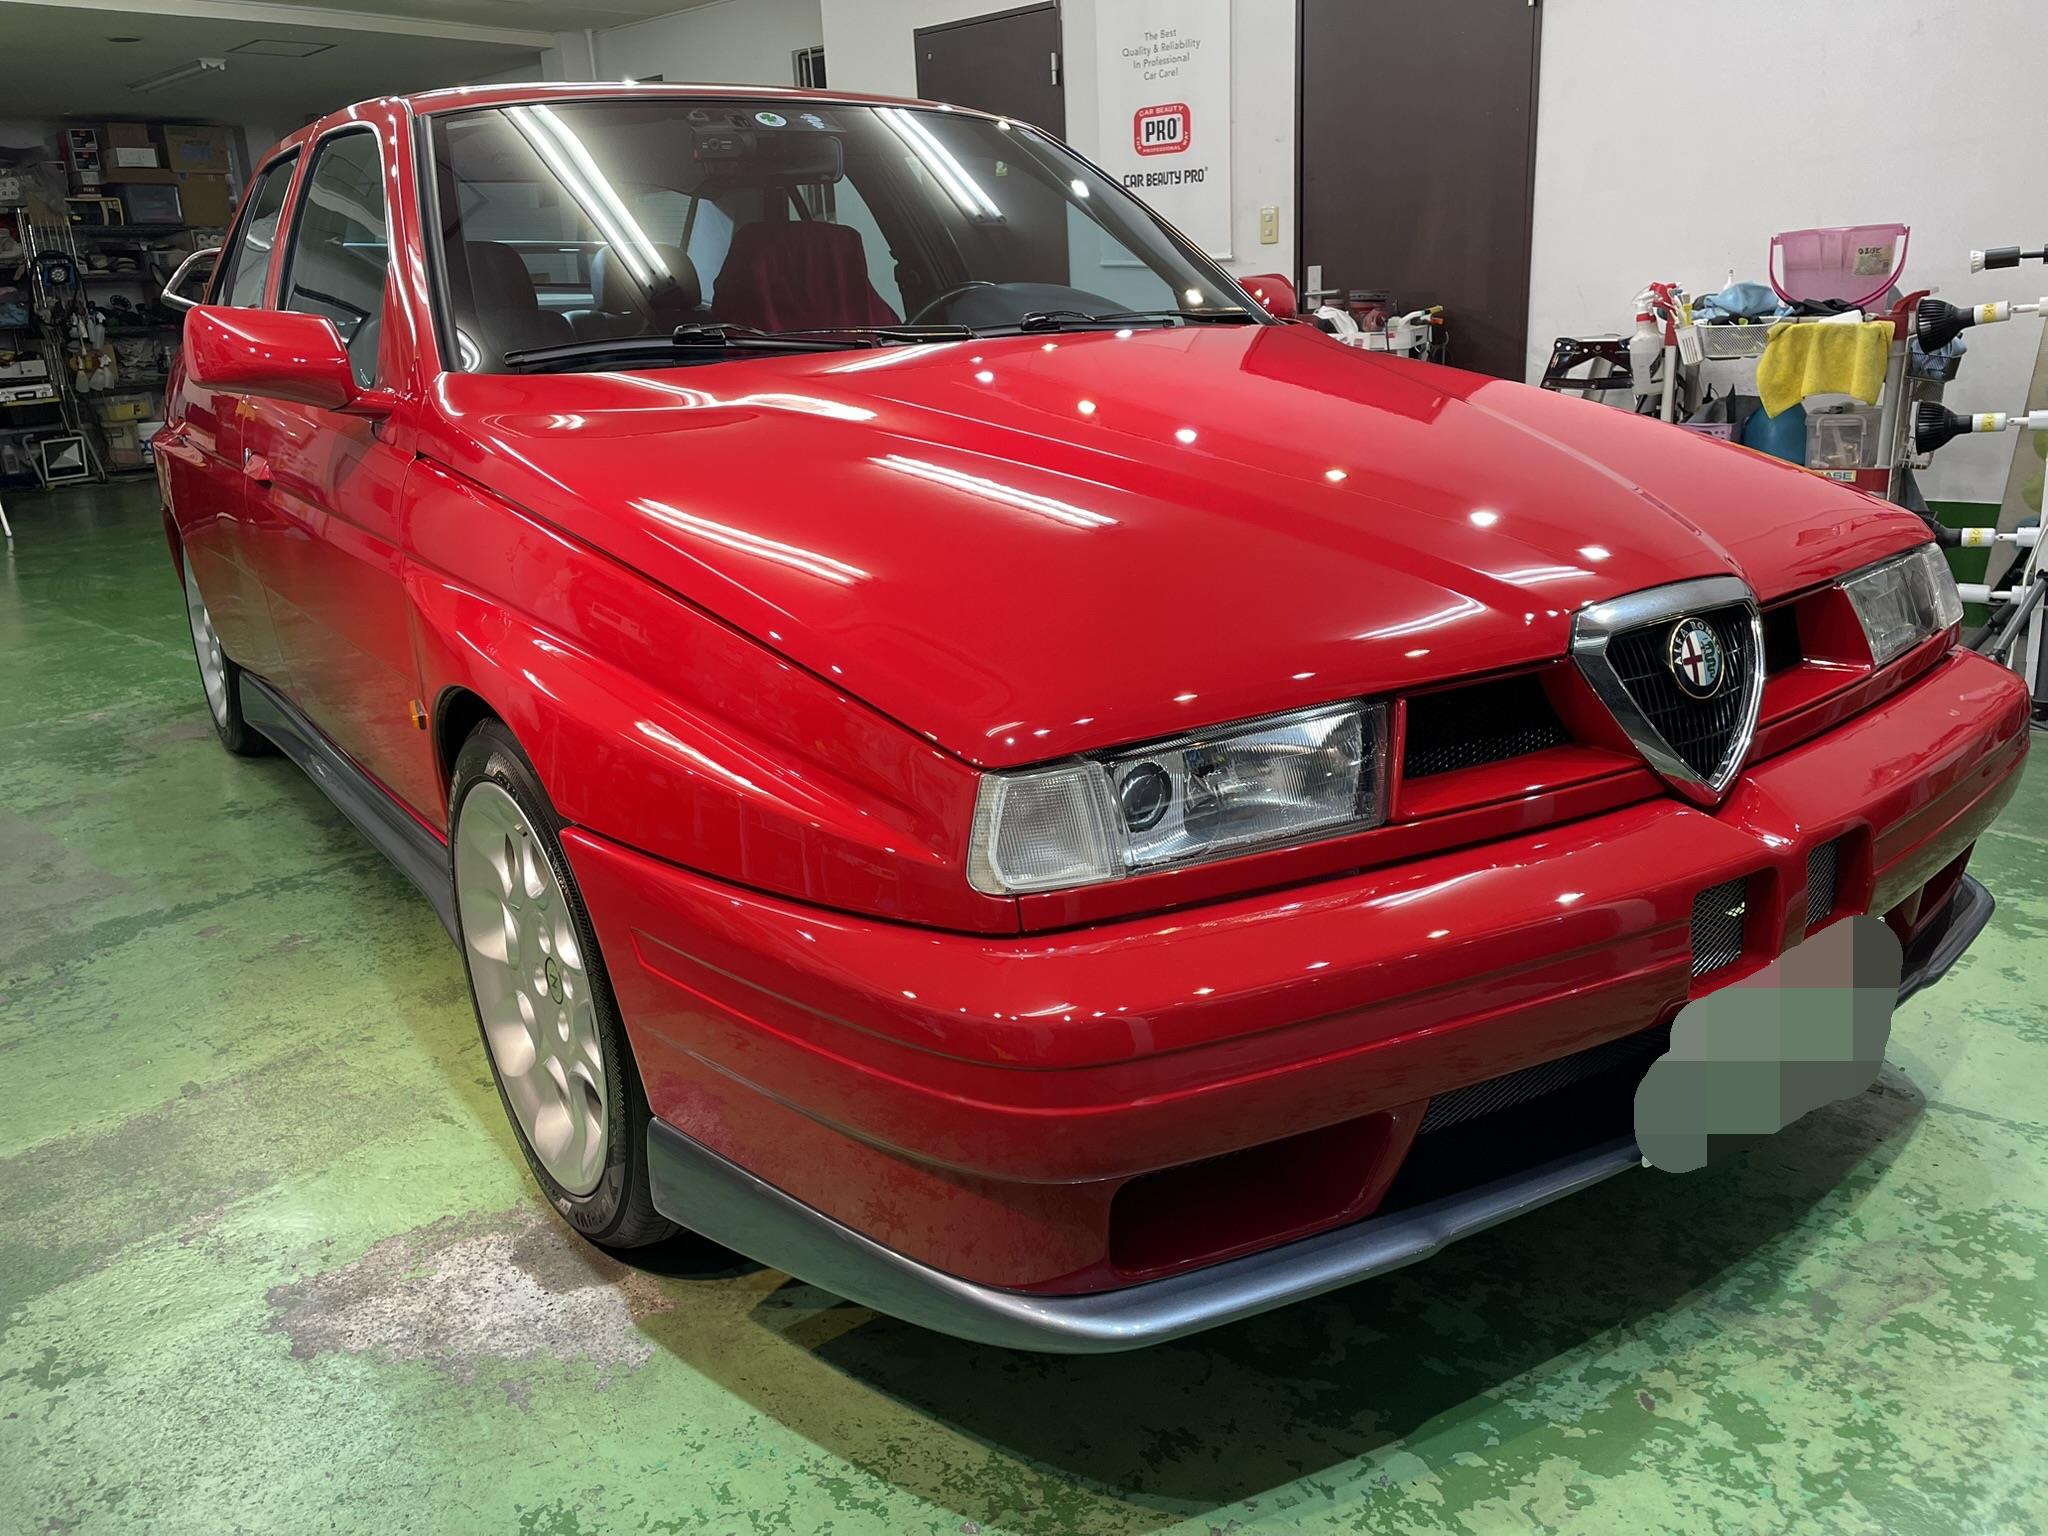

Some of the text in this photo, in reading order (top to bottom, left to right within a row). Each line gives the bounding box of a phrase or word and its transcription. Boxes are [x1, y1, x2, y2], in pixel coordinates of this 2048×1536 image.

[1144, 29, 1177, 41] The Best
[1122, 38, 1201, 57] Quality & Reliability
[1133, 51, 1190, 69] In Professional
[1144, 67, 1179, 80] Car Care!
[1139, 104, 1184, 117] CAR BEAUTY
[1145, 117, 1177, 143] PRO
[1123, 168, 1205, 188] CAR BEAUTY PRO
[1674, 628, 1689, 666] ALFA
